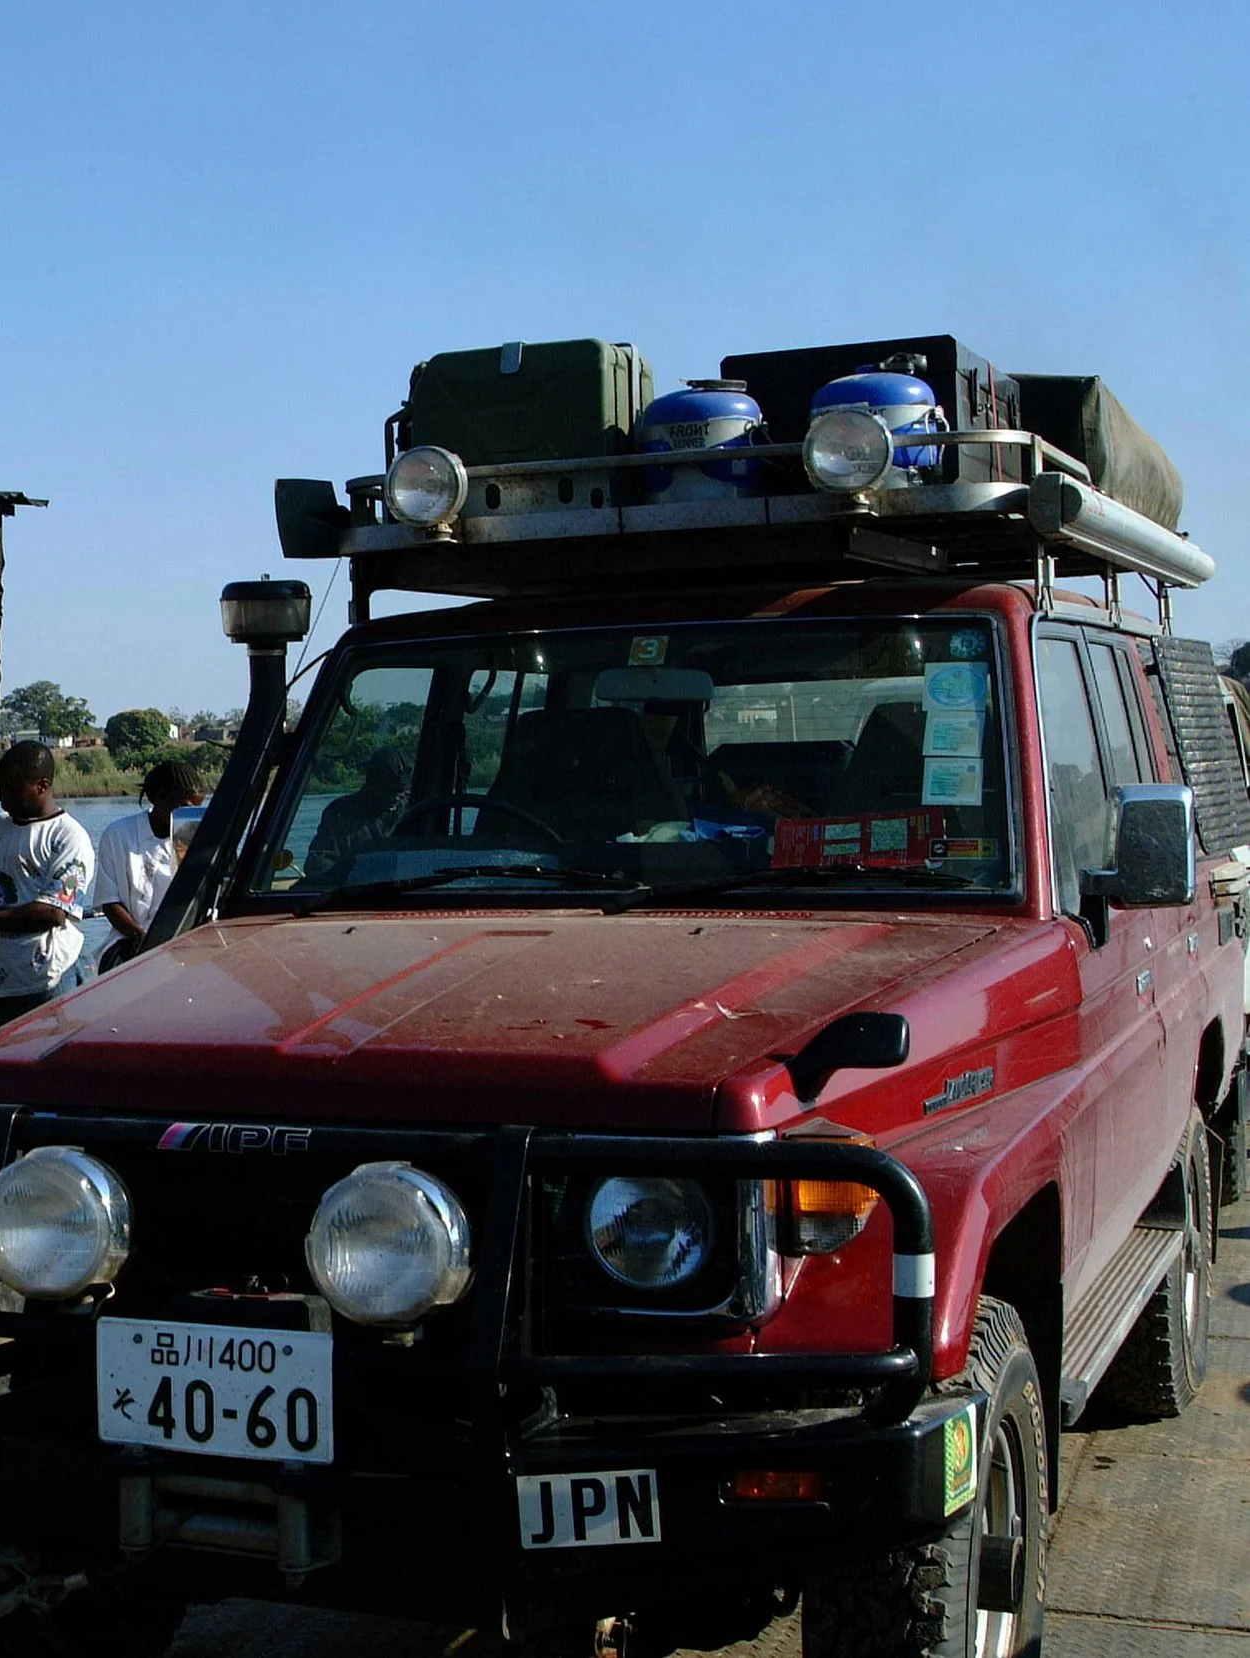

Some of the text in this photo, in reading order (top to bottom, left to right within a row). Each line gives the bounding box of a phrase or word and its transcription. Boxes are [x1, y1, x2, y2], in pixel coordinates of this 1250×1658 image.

[208, 1122, 312, 1156] IPF
[112, 1376, 318, 1451] そ 40-60
[531, 1474, 654, 1544] JPN
